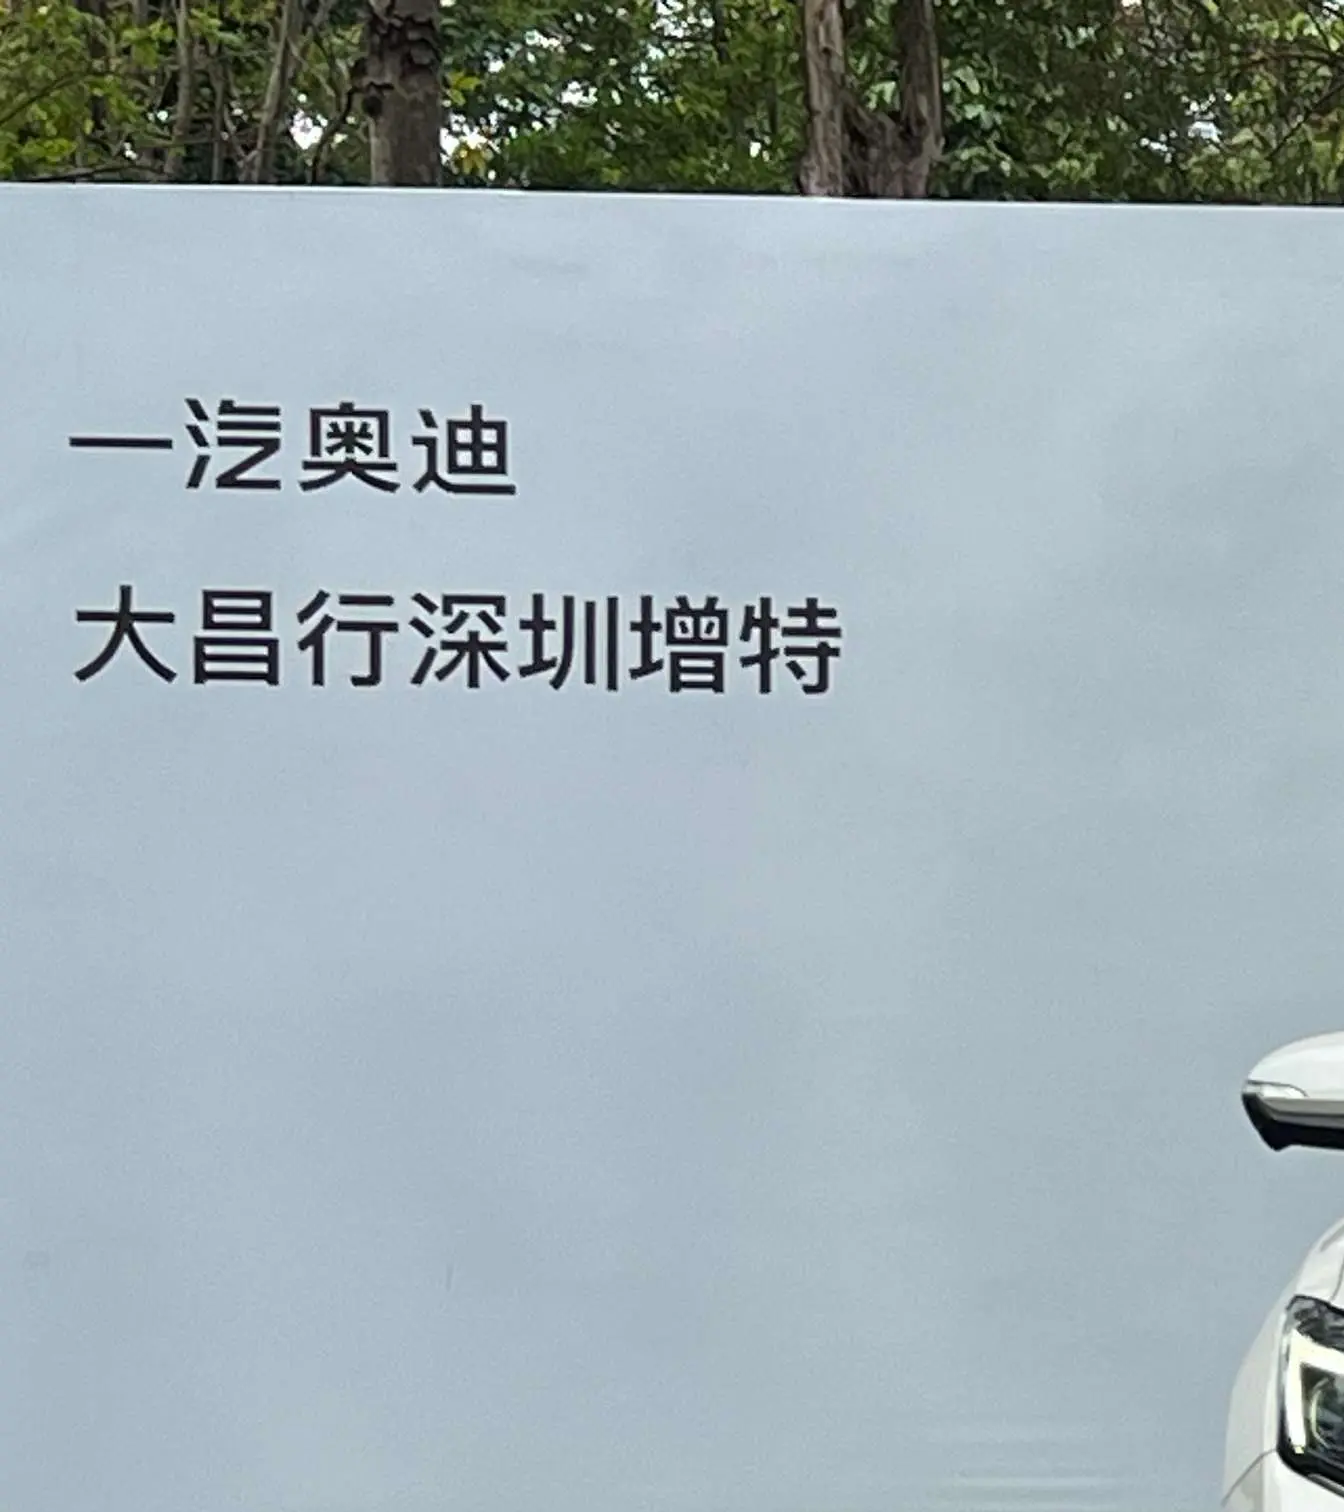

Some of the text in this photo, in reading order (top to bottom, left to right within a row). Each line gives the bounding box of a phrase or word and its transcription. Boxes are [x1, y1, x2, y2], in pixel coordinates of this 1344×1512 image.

[70, 398, 517, 497] 一汽奥迪
[75, 585, 843, 696] 大昌行深圳增特
